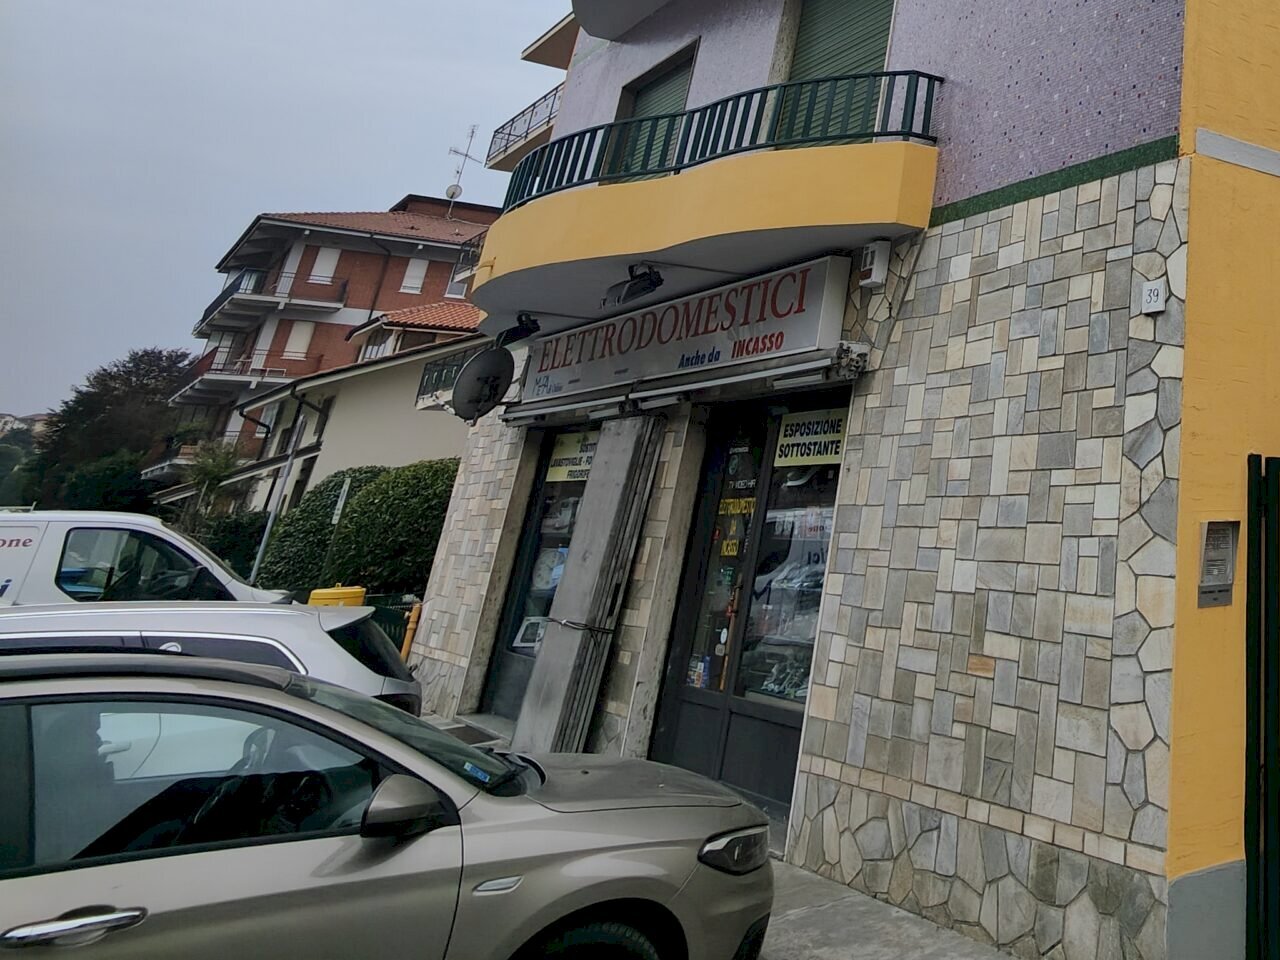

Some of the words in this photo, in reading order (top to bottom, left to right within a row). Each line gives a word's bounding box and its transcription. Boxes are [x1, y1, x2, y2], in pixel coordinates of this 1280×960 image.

[1145, 288, 1159, 304] 39
[537, 268, 811, 374] ELETTRODOMESTICI
[678, 349, 706, 369] Anche
[708, 346, 721, 363] da
[731, 331, 784, 359] INCASSO
[783, 418, 842, 439] ESPOSIZIONE
[778, 439, 842, 458] SOTTOSTANTE
